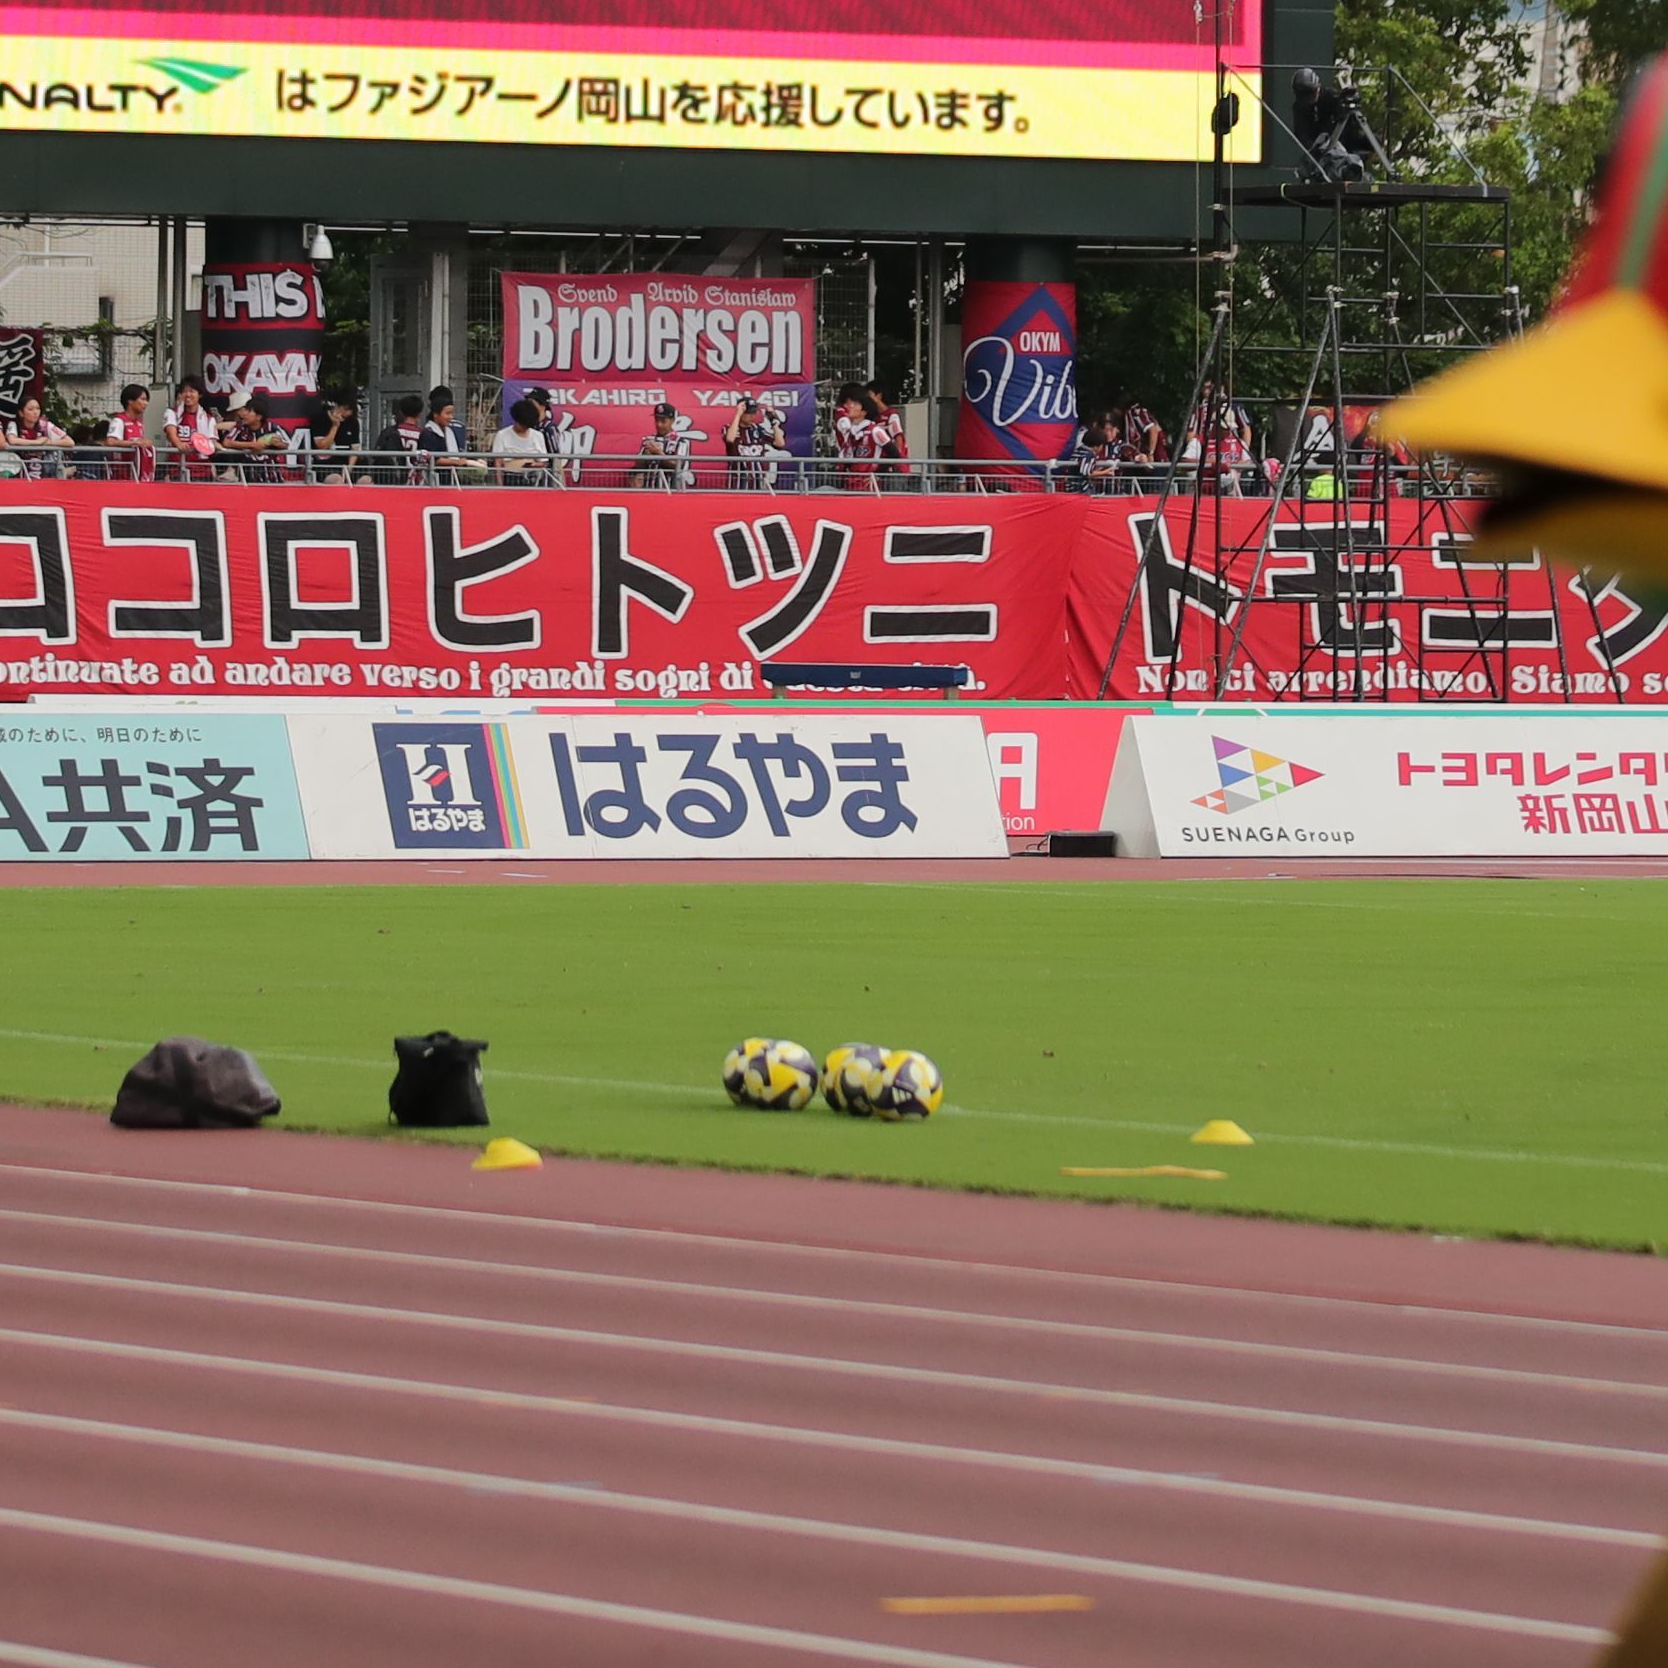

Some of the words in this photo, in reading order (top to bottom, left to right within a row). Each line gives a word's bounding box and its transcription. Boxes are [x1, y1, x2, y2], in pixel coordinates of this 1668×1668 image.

[276, 67, 1031, 136] はファジアーノ岡山を応援しています。
[204, 268, 309, 319] THIS
[517, 284, 803, 375] Brodersen
[1019, 331, 1061, 353] OKYM
[168, 654, 216, 686] ad
[223, 654, 352, 688] andare
[360, 662, 461, 692] verso
[468, 659, 483, 692] i
[490, 660, 606, 699] grandi
[613, 660, 712, 700] sogni
[718, 660, 754, 692] di
[1136, 664, 1207, 694] Non
[1510, 664, 1630, 695] Siamo
[548, 732, 919, 839] はるやま
[407, 807, 487, 833] はるやま
[1181, 826, 1291, 844] SUENAGA
[1293, 826, 1356, 847] Group
